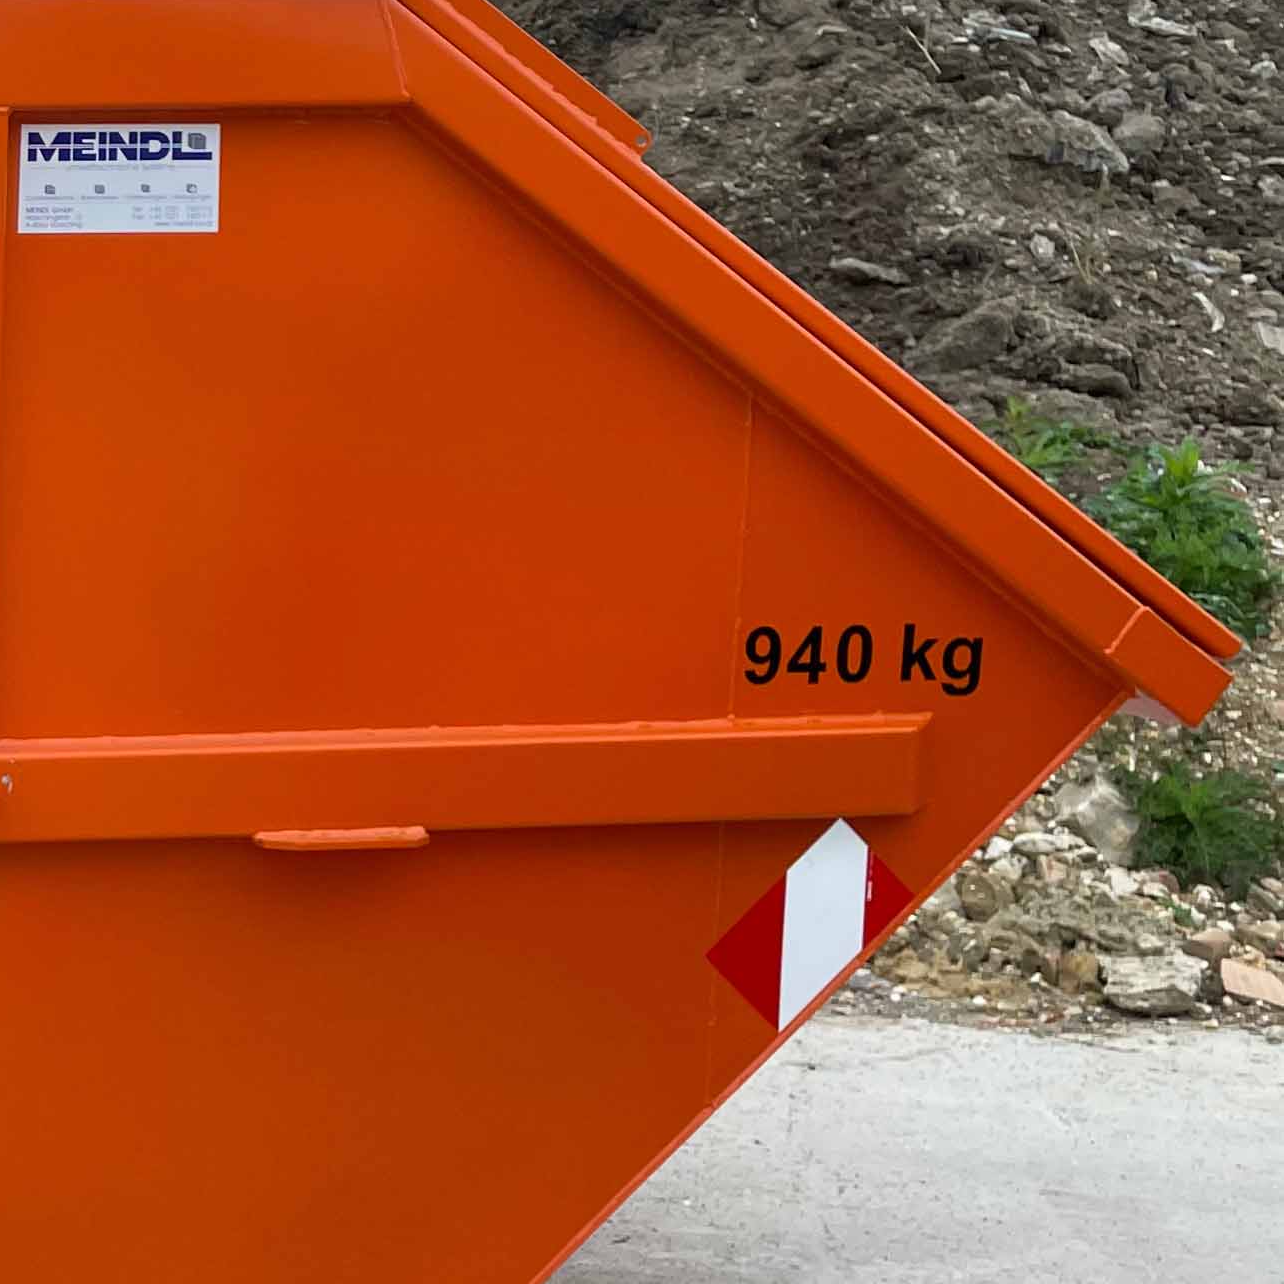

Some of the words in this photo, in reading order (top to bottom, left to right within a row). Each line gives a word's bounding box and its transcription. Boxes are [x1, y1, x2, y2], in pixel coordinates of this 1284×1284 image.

[27, 130, 213, 162] MEINDL
[744, 624, 873, 685] 940
[900, 623, 984, 697] kg
